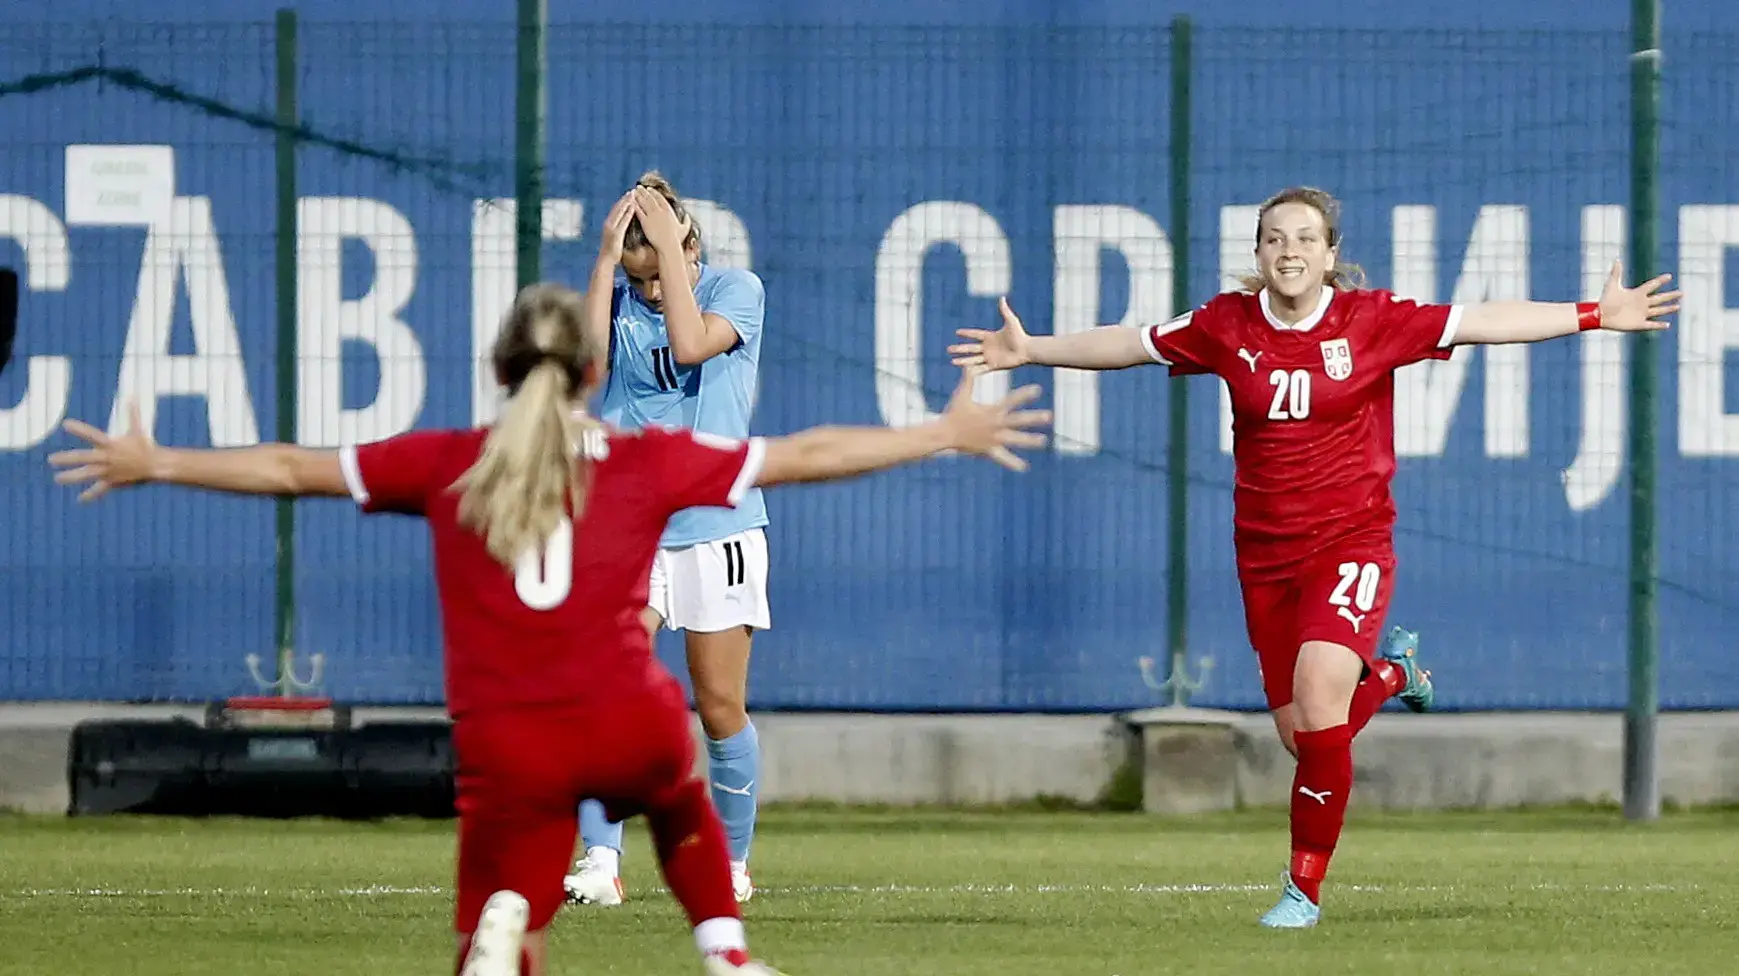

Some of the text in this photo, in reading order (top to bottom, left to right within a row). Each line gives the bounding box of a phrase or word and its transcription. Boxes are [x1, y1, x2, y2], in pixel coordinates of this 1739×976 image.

[650, 346, 679, 391] 11
[874, 200, 1739, 512] СРИЈЕ
[1267, 369, 1311, 420] 20
[723, 540, 744, 587] 11
[1328, 561, 1380, 612] 20
